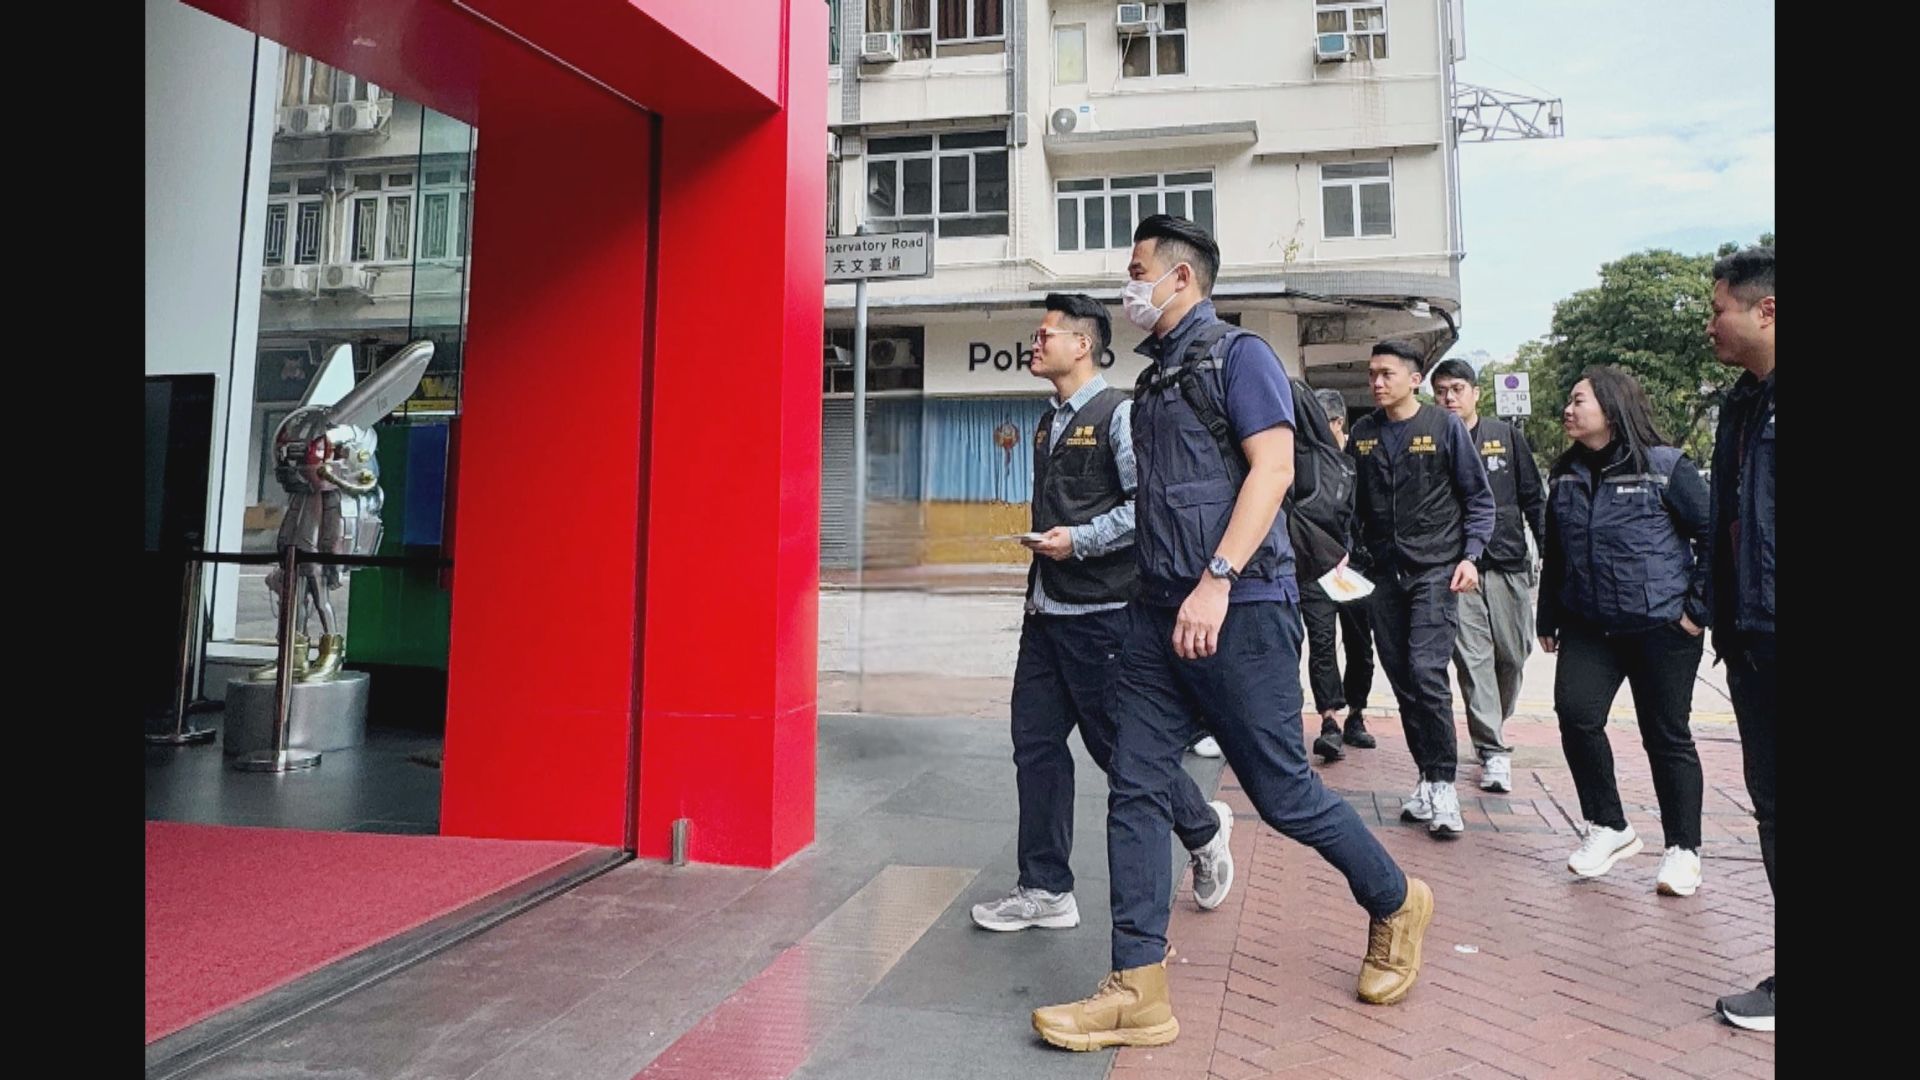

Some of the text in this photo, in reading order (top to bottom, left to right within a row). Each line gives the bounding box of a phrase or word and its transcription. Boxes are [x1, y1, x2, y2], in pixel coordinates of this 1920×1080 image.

[892, 236, 923, 249] Road
[833, 256, 901, 273] 天文臺道
